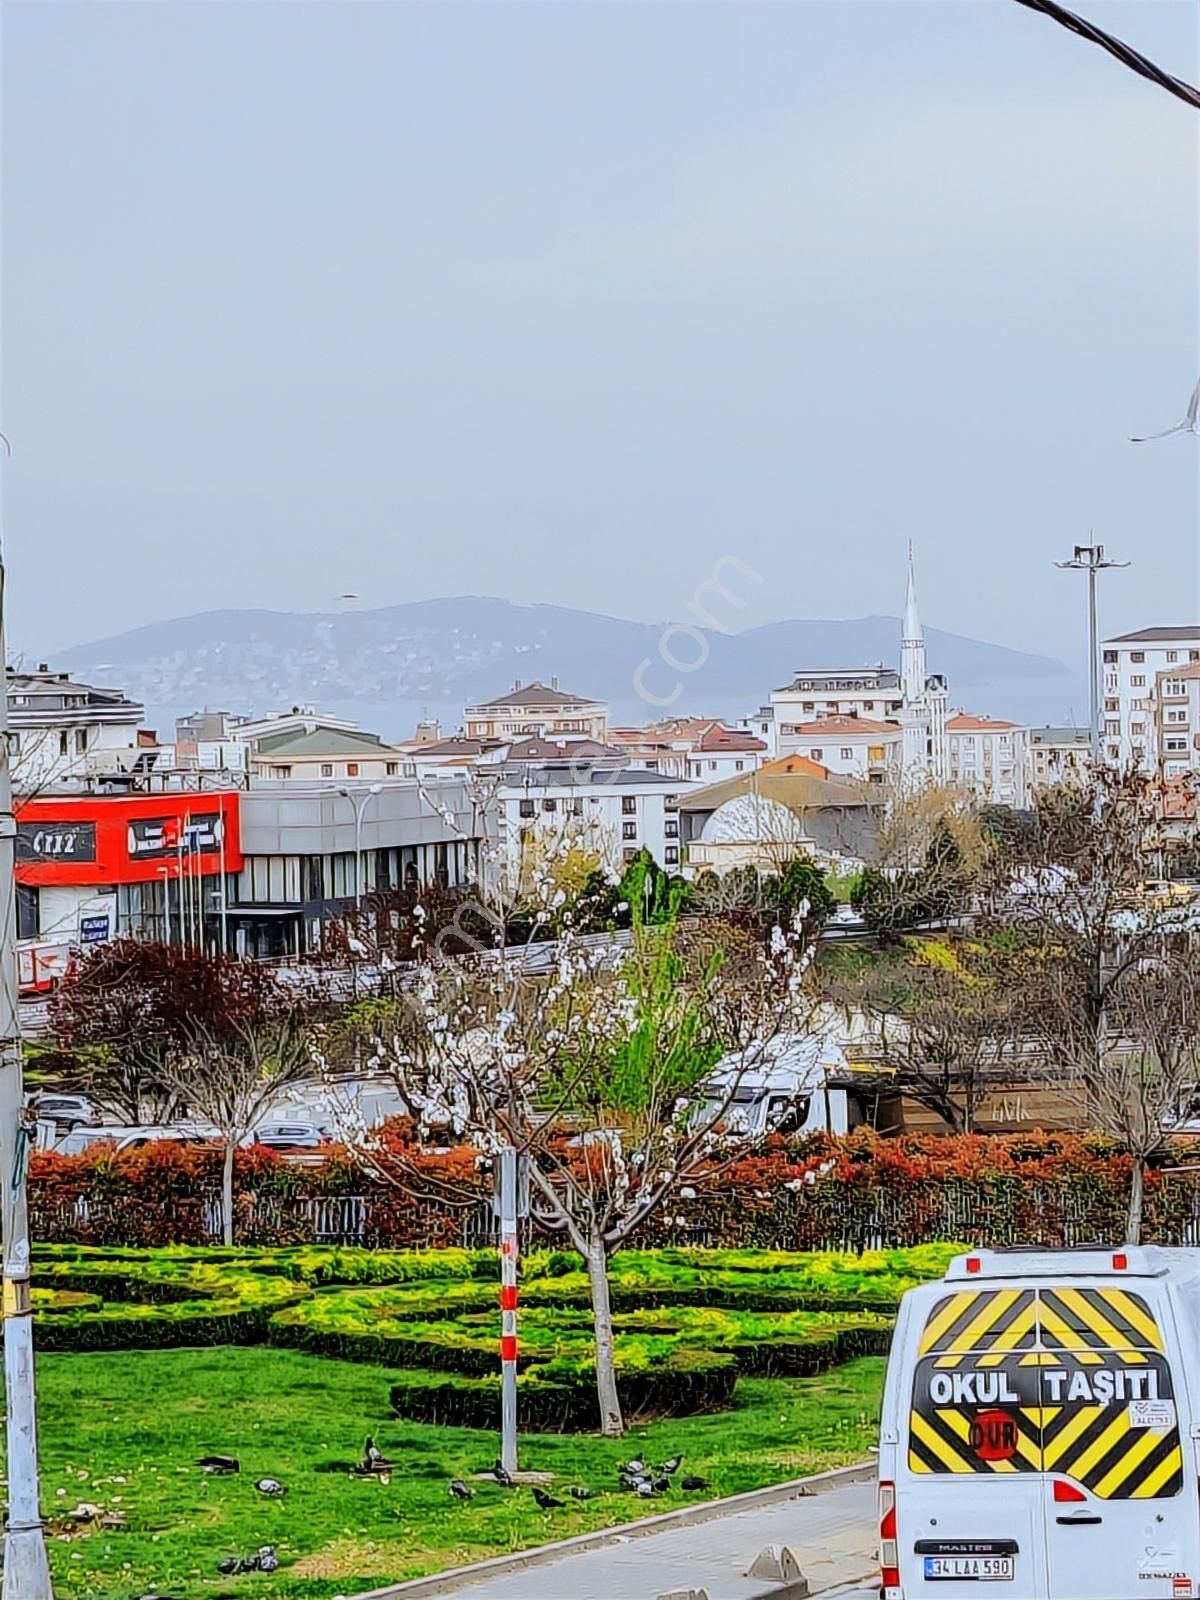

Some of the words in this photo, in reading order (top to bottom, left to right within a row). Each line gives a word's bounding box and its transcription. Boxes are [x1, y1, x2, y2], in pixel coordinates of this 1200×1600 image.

[929, 1371, 1019, 1404] OKUL
[1043, 1368, 1158, 1409] TAŞITI
[971, 1421, 1016, 1450] DUR
[933, 1560, 950, 1575] 34
[983, 1560, 1010, 1575] 590
